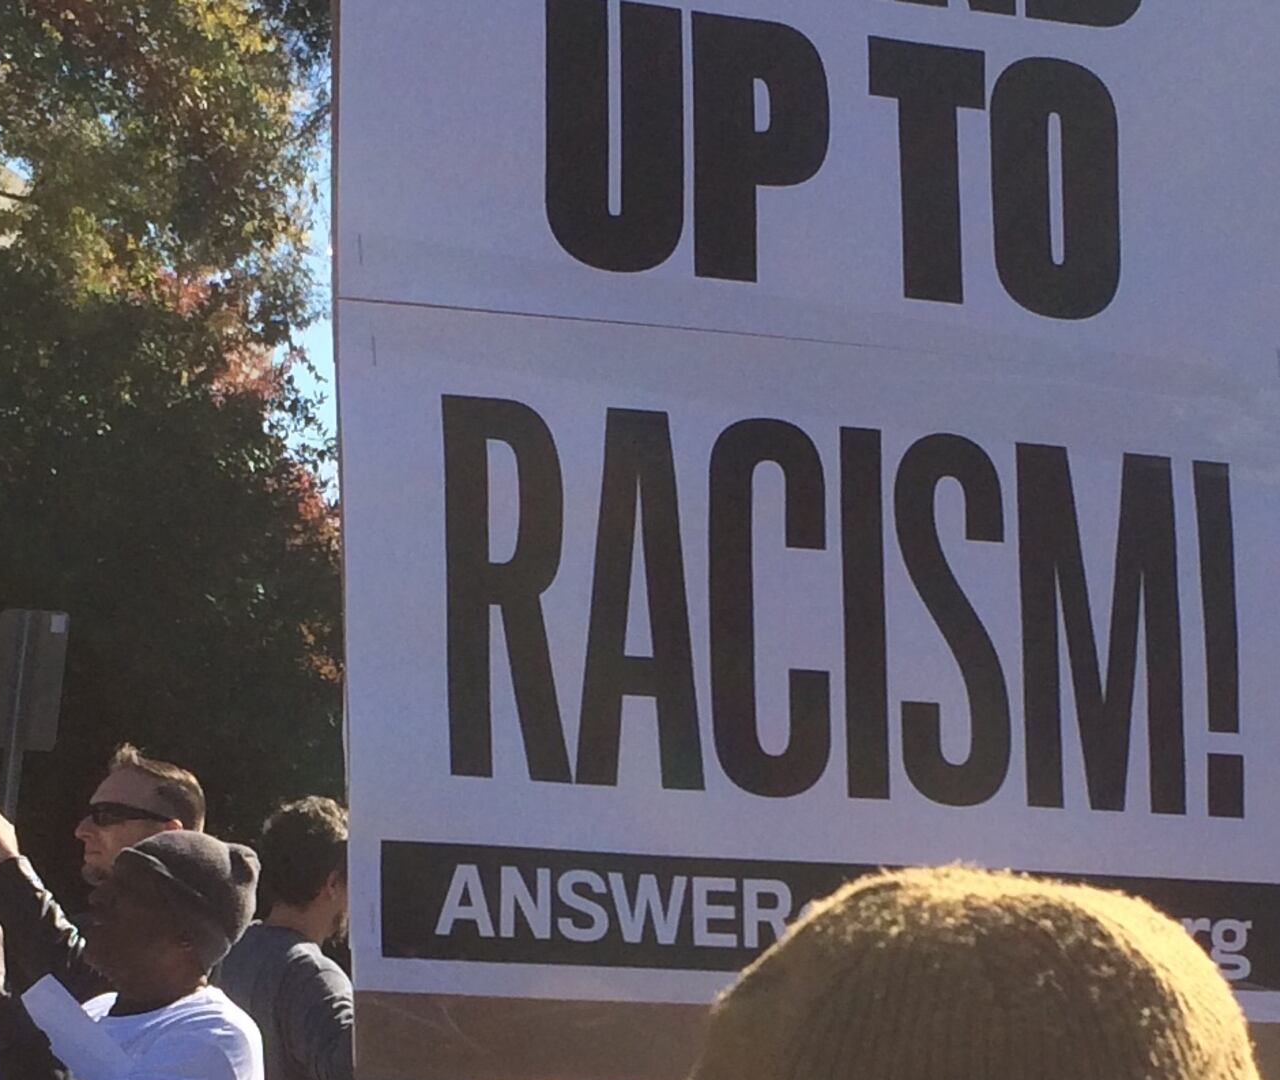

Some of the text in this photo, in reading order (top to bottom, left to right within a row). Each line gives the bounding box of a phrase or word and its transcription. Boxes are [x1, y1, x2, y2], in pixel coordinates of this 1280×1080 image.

[545, 0, 1121, 320] UP TO
[441, 394, 1244, 818] RACISM!
[435, 863, 794, 949] ANSWER
